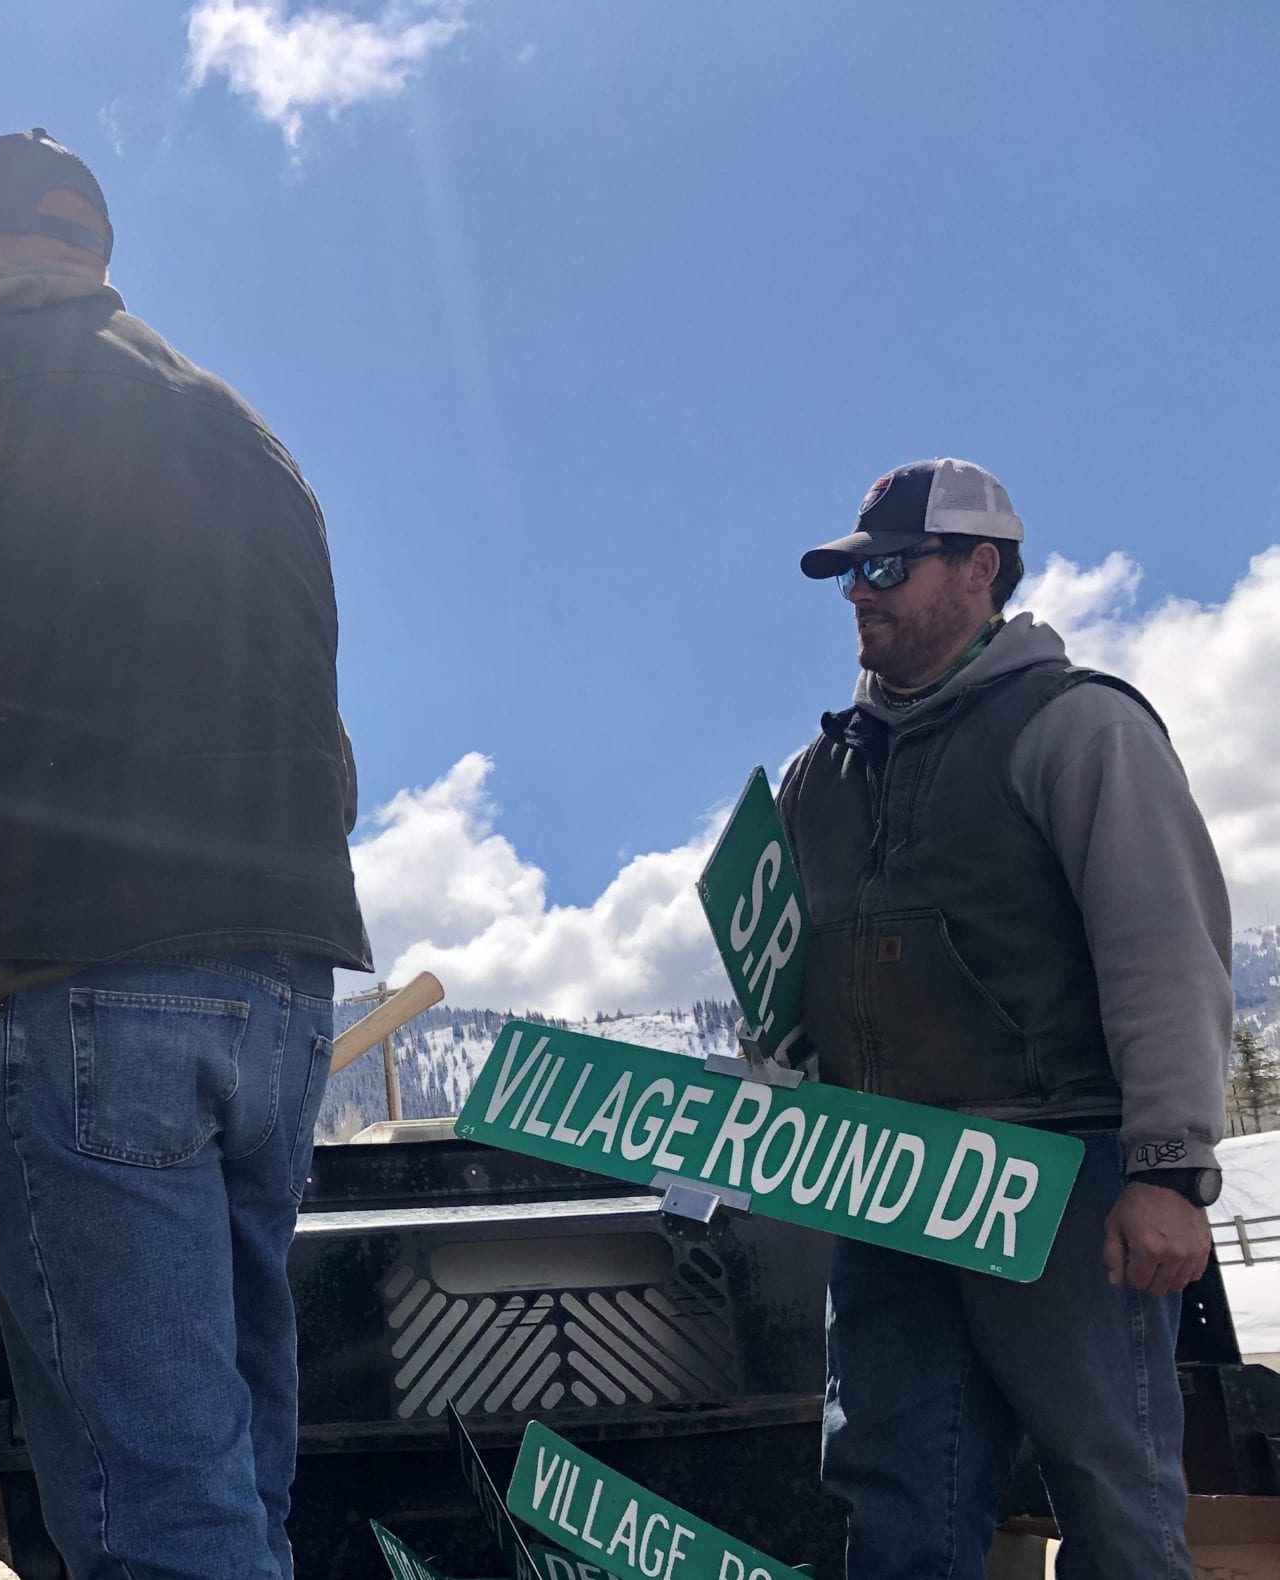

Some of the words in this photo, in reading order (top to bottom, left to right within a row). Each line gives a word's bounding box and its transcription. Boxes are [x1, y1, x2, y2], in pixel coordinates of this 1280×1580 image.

[460, 1124, 476, 1135] 21
[483, 1030, 713, 1172] VILLAGE
[702, 1080, 925, 1225] ROUND
[923, 1128, 1040, 1258] DR
[532, 1446, 696, 1580] VILLAGE
